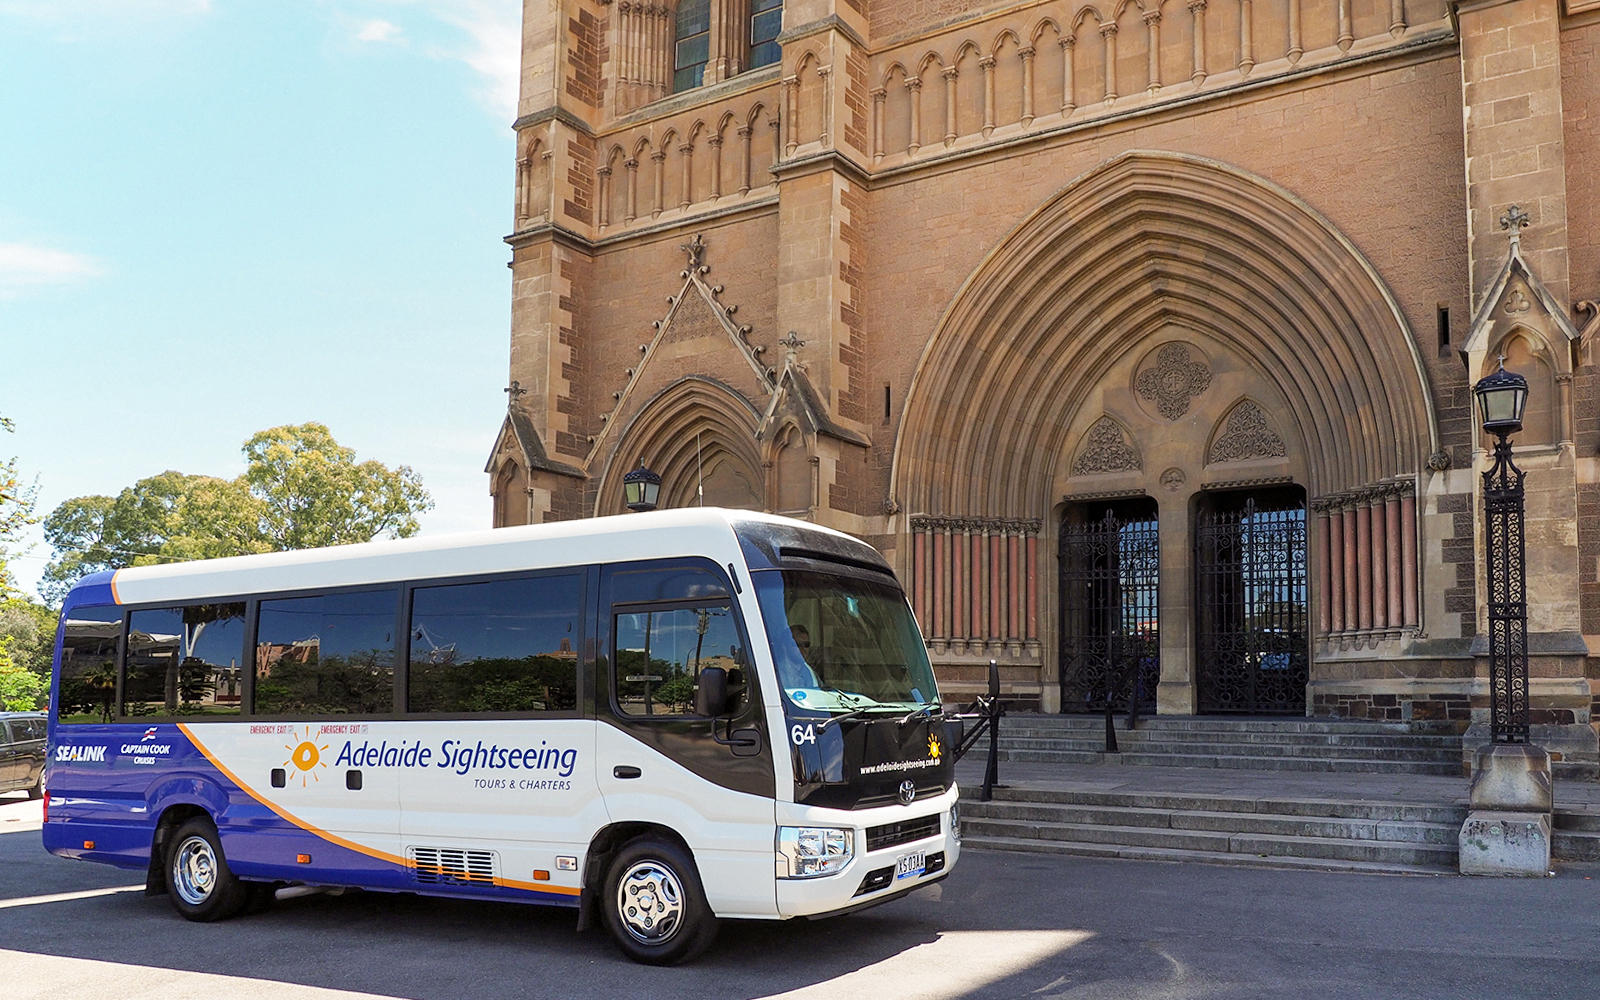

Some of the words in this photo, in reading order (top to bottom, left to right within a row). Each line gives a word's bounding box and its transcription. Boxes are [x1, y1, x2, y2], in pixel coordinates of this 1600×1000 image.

[250, 725, 275, 734] EMERGENCY
[277, 725, 287, 734] EXIT
[321, 725, 348, 734] EMERGENCY
[350, 725, 361, 734] EXIT
[791, 724, 816, 745] 64
[55, 746, 107, 762] SEALINK
[120, 743, 149, 754] CAPTAIN
[149, 744, 171, 754] COOK
[133, 756, 156, 765] CRUISES
[335, 740, 432, 768] Adelaide
[437, 739, 578, 777] Sightseeing
[474, 778, 506, 789] TOURS
[508, 779, 516, 789] &
[519, 779, 571, 791] CHARTERS
